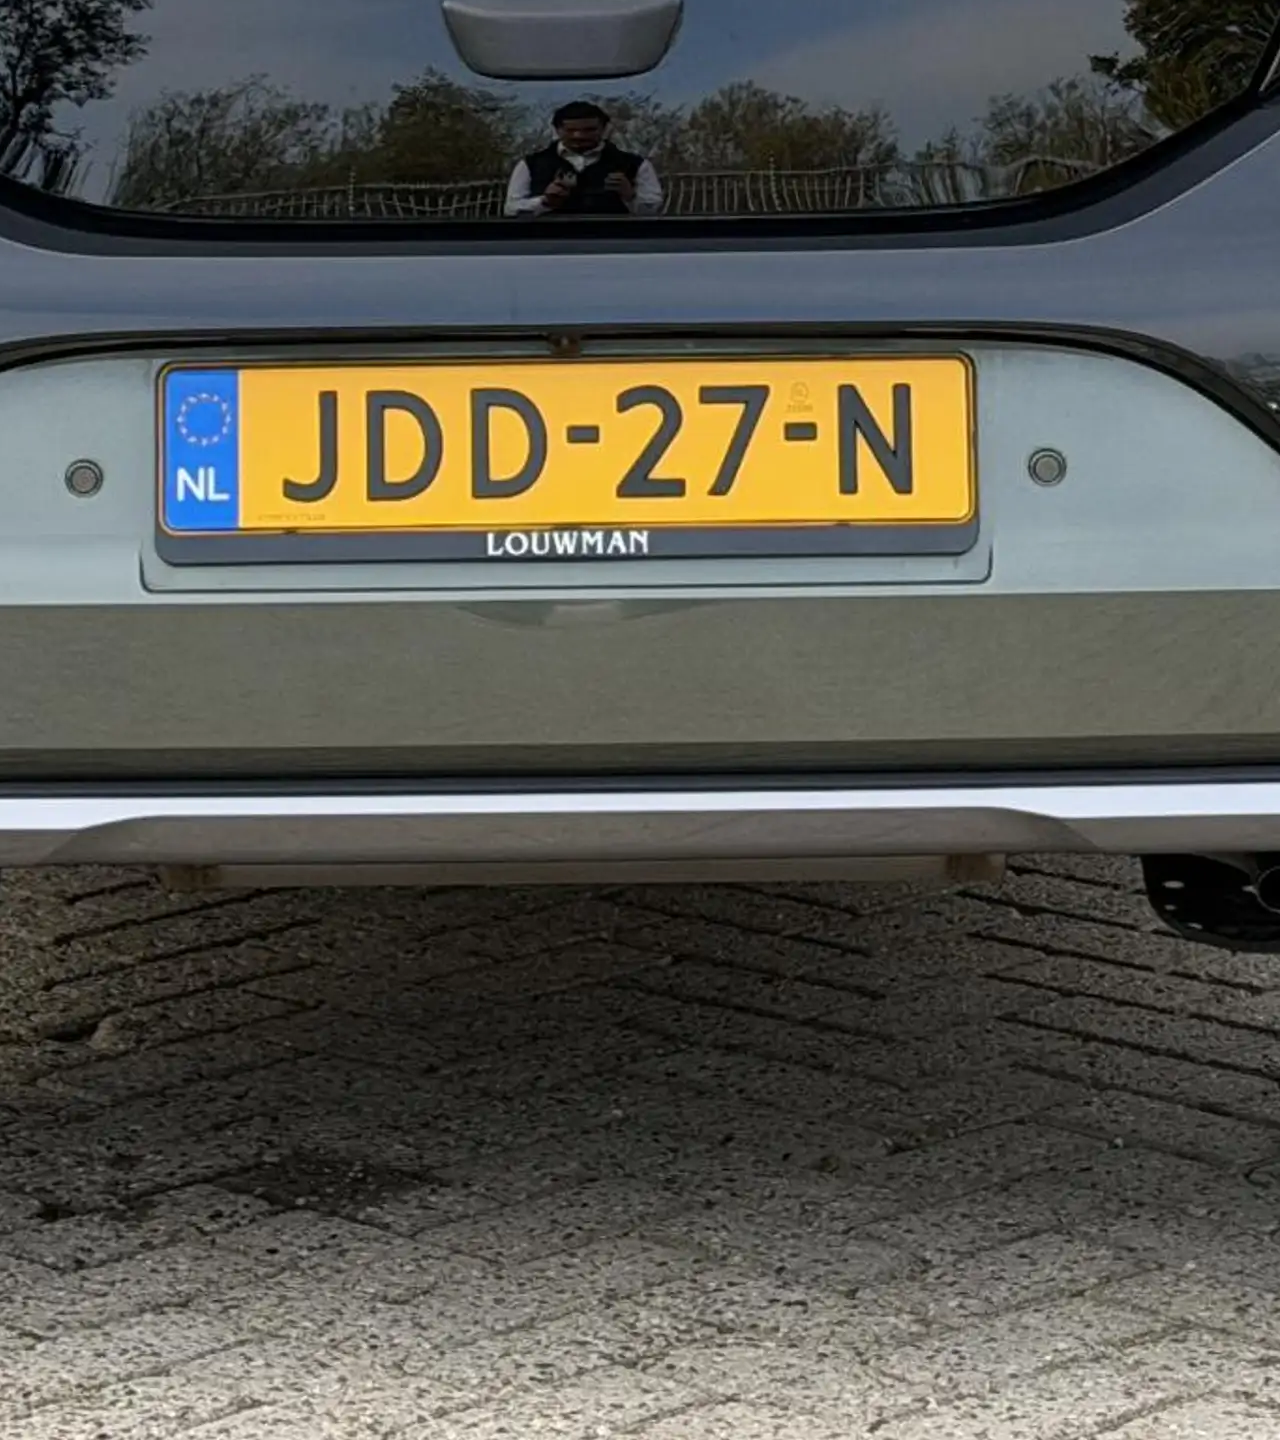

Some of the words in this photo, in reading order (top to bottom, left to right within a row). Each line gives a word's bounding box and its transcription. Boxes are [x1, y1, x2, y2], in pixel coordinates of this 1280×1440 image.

[282, 383, 914, 502] JDD-27-N
[176, 466, 230, 502] NL
[486, 530, 649, 556] LOUWMAN
